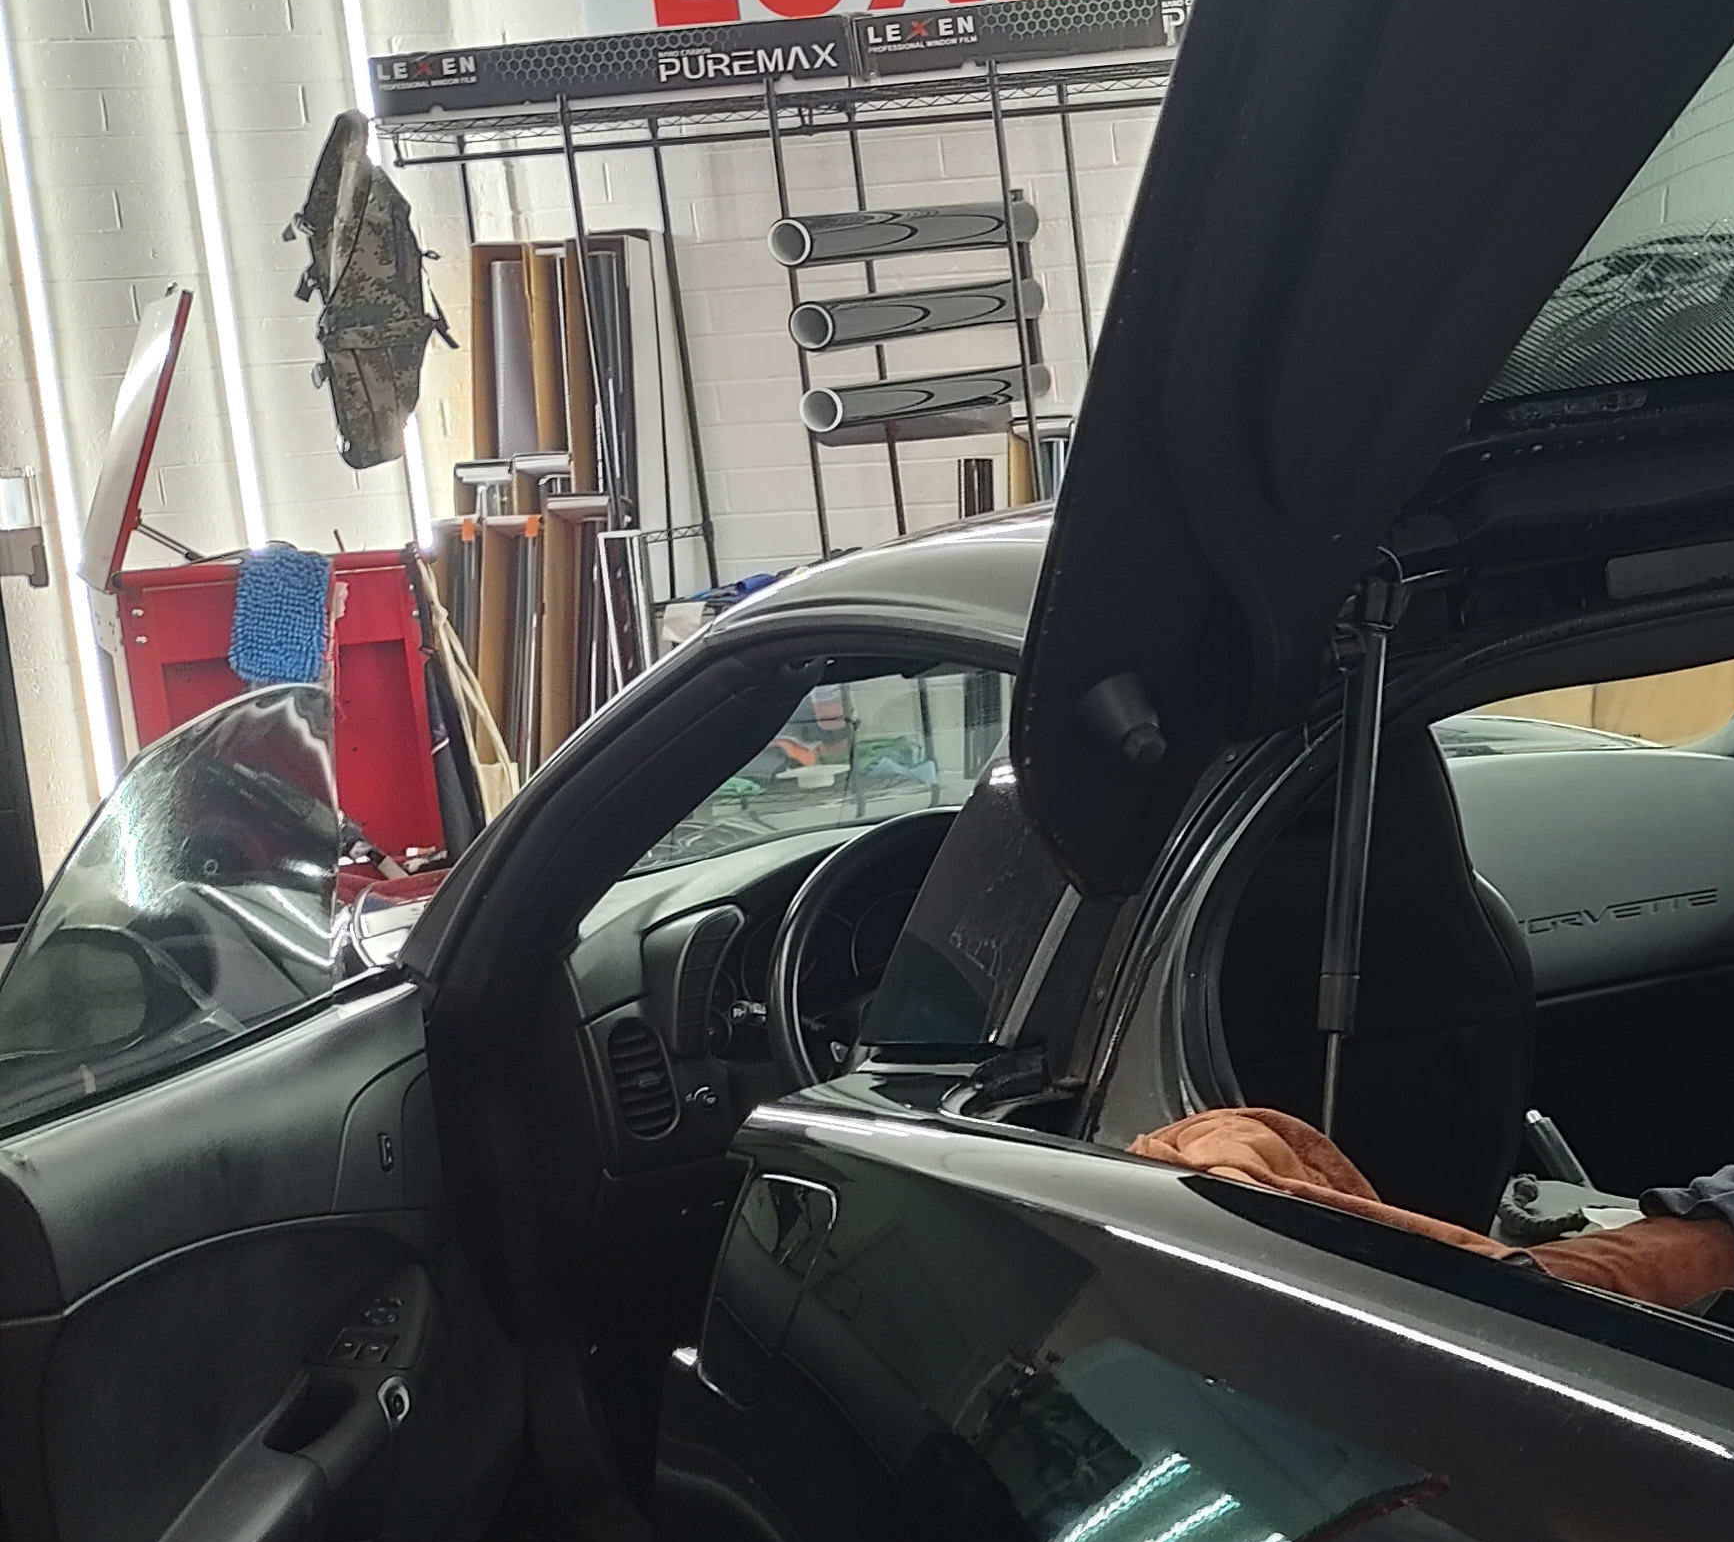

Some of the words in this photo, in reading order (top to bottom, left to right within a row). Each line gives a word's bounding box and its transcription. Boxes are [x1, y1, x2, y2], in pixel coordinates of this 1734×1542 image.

[866, 15, 975, 45] LEXEN
[868, 41, 925, 54] PROFESSIONAL
[926, 38, 958, 48] WINDOW
[959, 34, 978, 45] FILM
[376, 55, 477, 82] LEXEN
[658, 42, 838, 83] PUREMAX
[1518, 888, 1718, 935] ORVETTE
